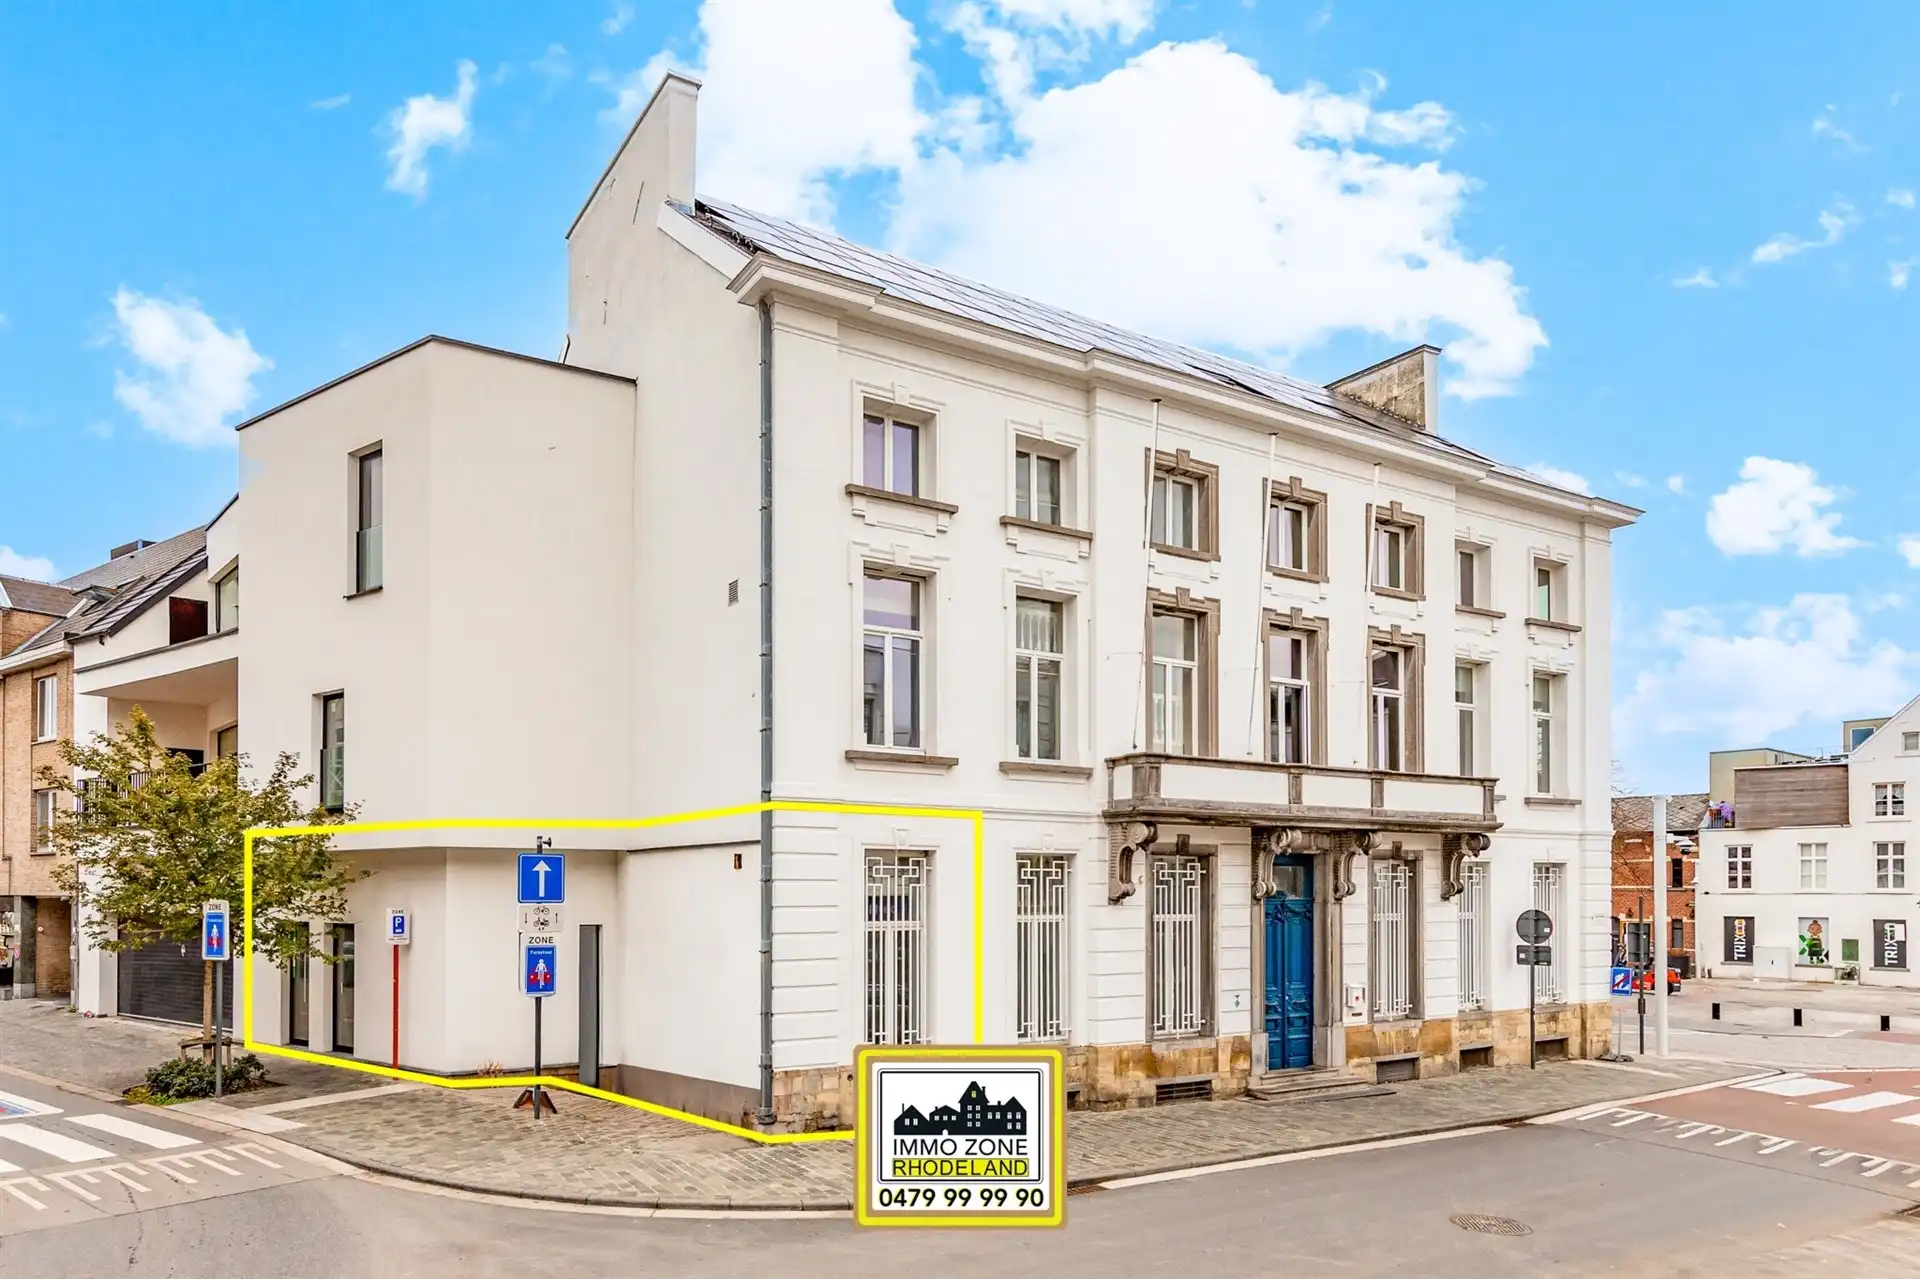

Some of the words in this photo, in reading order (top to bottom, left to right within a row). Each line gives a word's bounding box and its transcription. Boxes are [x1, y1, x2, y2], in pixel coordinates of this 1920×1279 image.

[208, 903, 222, 911] ZONE
[395, 917, 402, 928] P
[528, 936, 554, 944] ZONE
